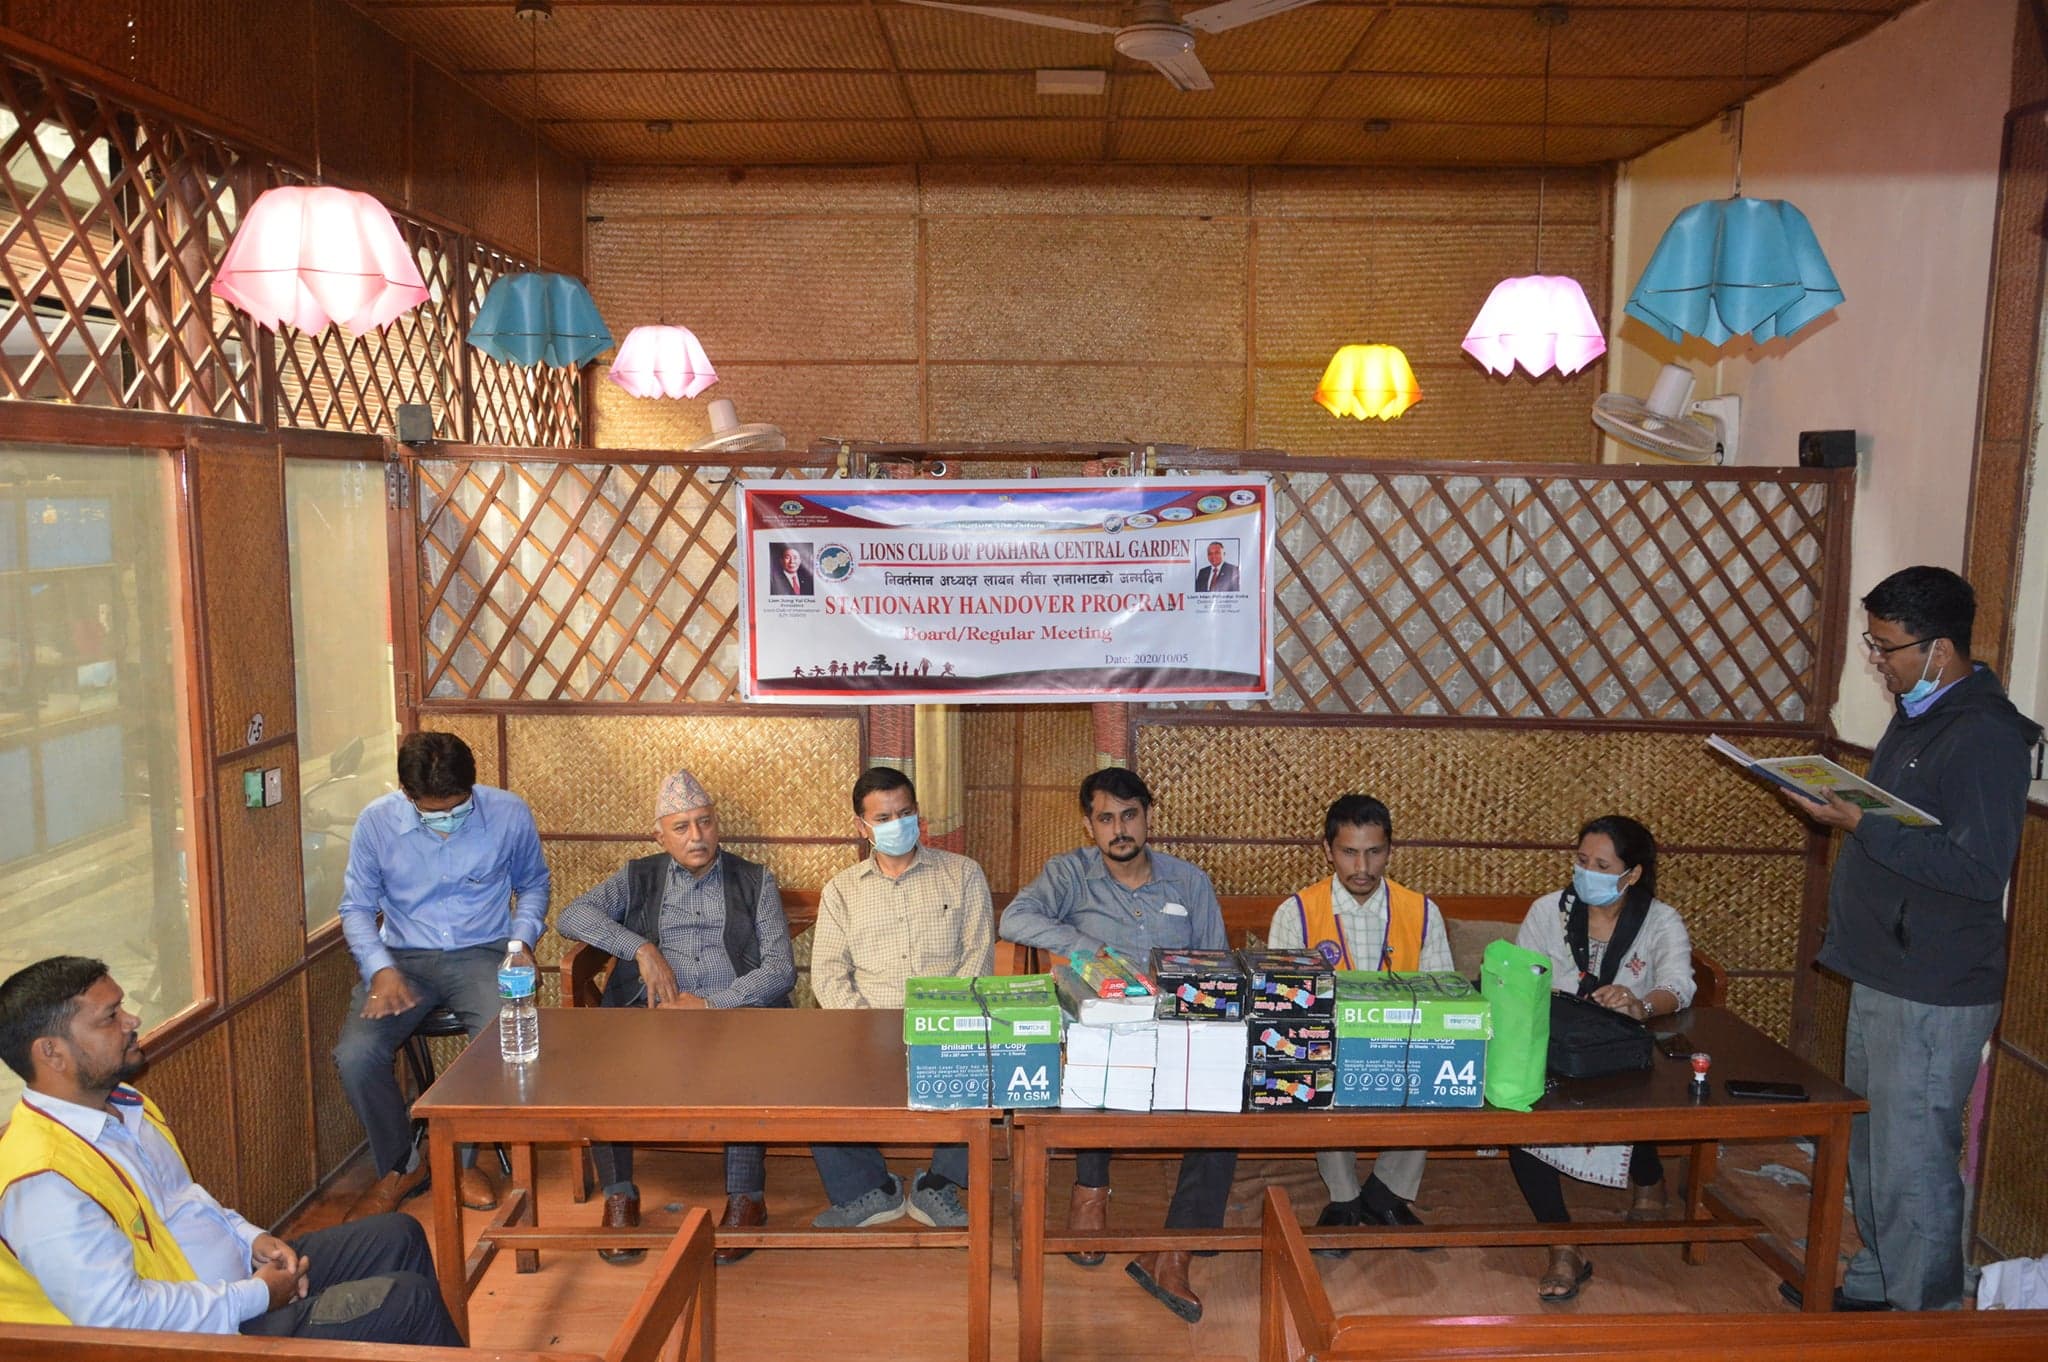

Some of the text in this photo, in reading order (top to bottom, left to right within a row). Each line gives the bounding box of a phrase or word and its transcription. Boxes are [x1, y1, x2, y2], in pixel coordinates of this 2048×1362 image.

[860, 539, 1190, 561] LIONS CLUB OF POKHARA CENTRAL GARDEN
[884, 571, 934, 586] निवर्तमान
[940, 575, 978, 587] अध्यक्ष
[1119, 568, 1164, 584] जन्मदिन
[825, 592, 1185, 615] STATIONARY HANDOVER PROGRAM
[904, 624, 1113, 644] Board/Regular Meeting
[1105, 653, 1189, 665] Date: 2020/10/05
[915, 1016, 950, 1031] BLC
[1344, 1008, 1380, 1023] BLC
[1007, 1065, 1050, 1091] A4
[1433, 1060, 1477, 1085] A4
[1007, 1091, 1051, 1101] 70 GSM
[1432, 1086, 1477, 1096] 70 GSM
